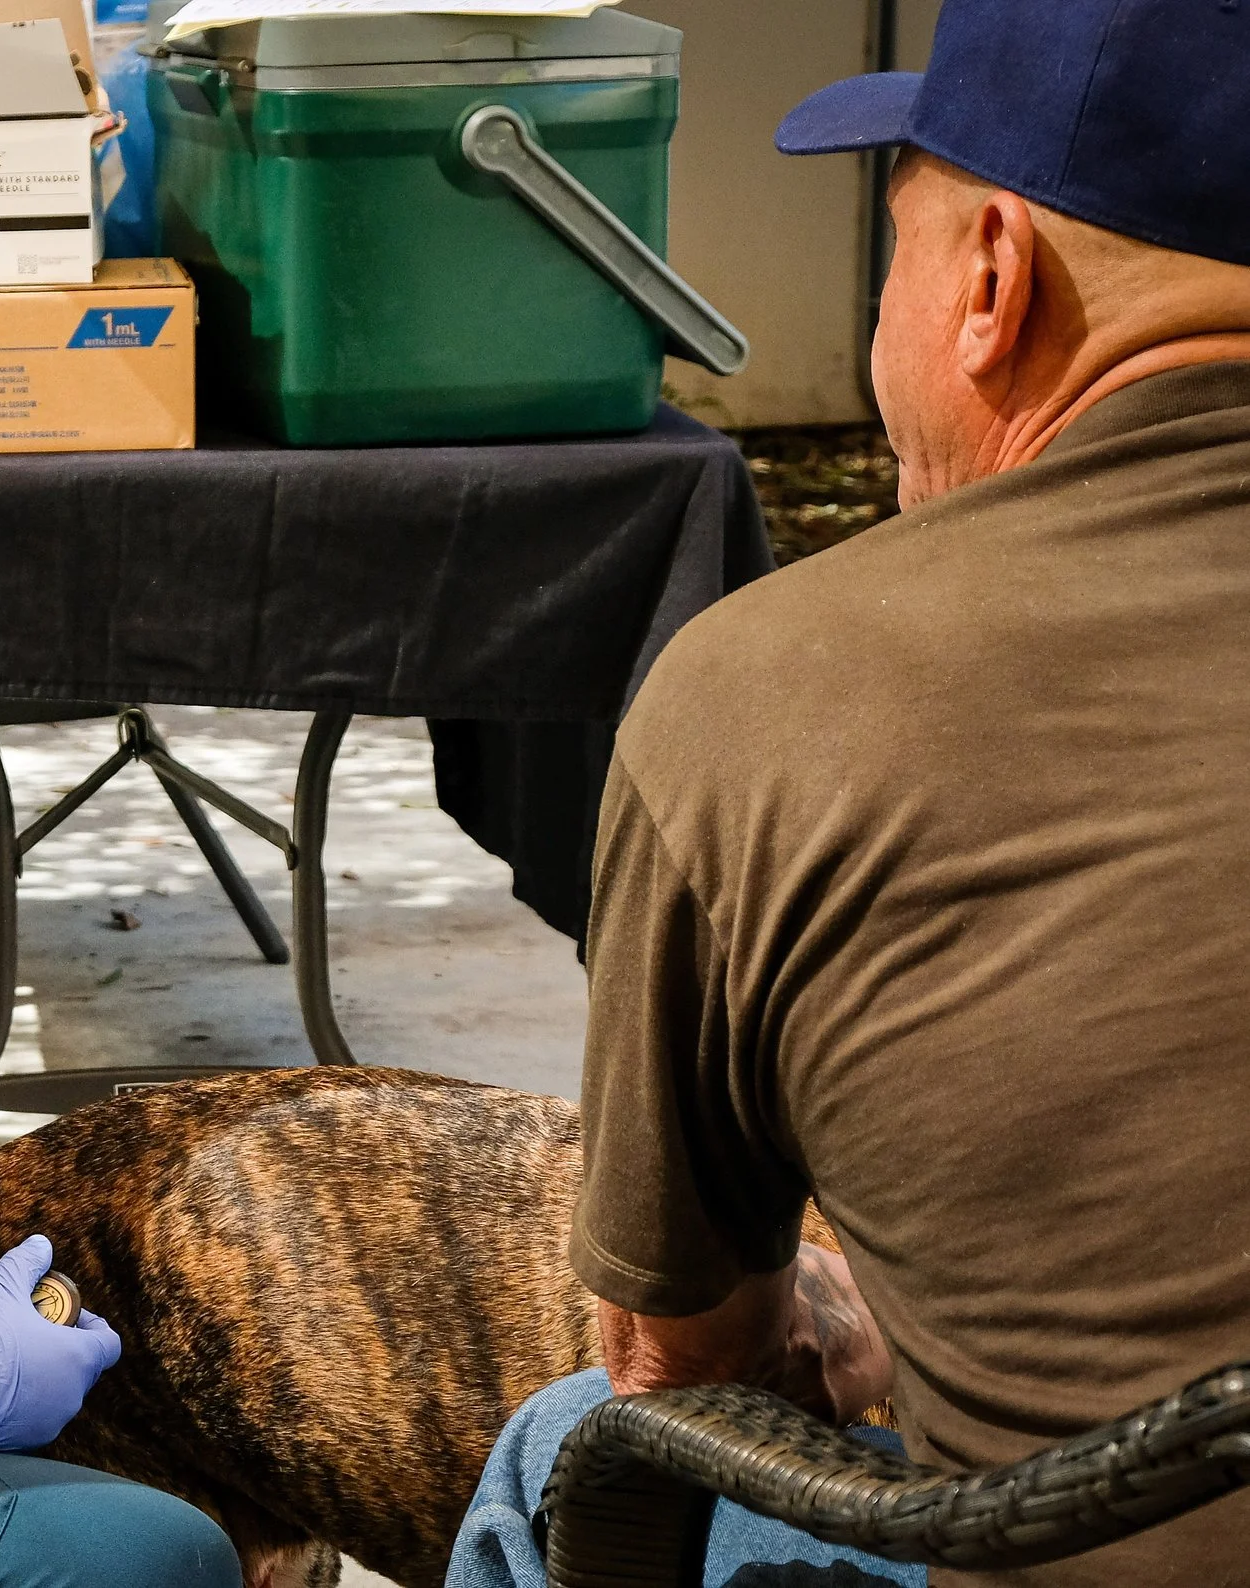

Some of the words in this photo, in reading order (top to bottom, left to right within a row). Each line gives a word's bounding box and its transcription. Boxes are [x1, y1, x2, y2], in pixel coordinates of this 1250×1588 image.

[26, 174, 80, 183] STANDARD
[83, 338, 106, 346] WITH
[107, 337, 141, 345] NEEDLE
